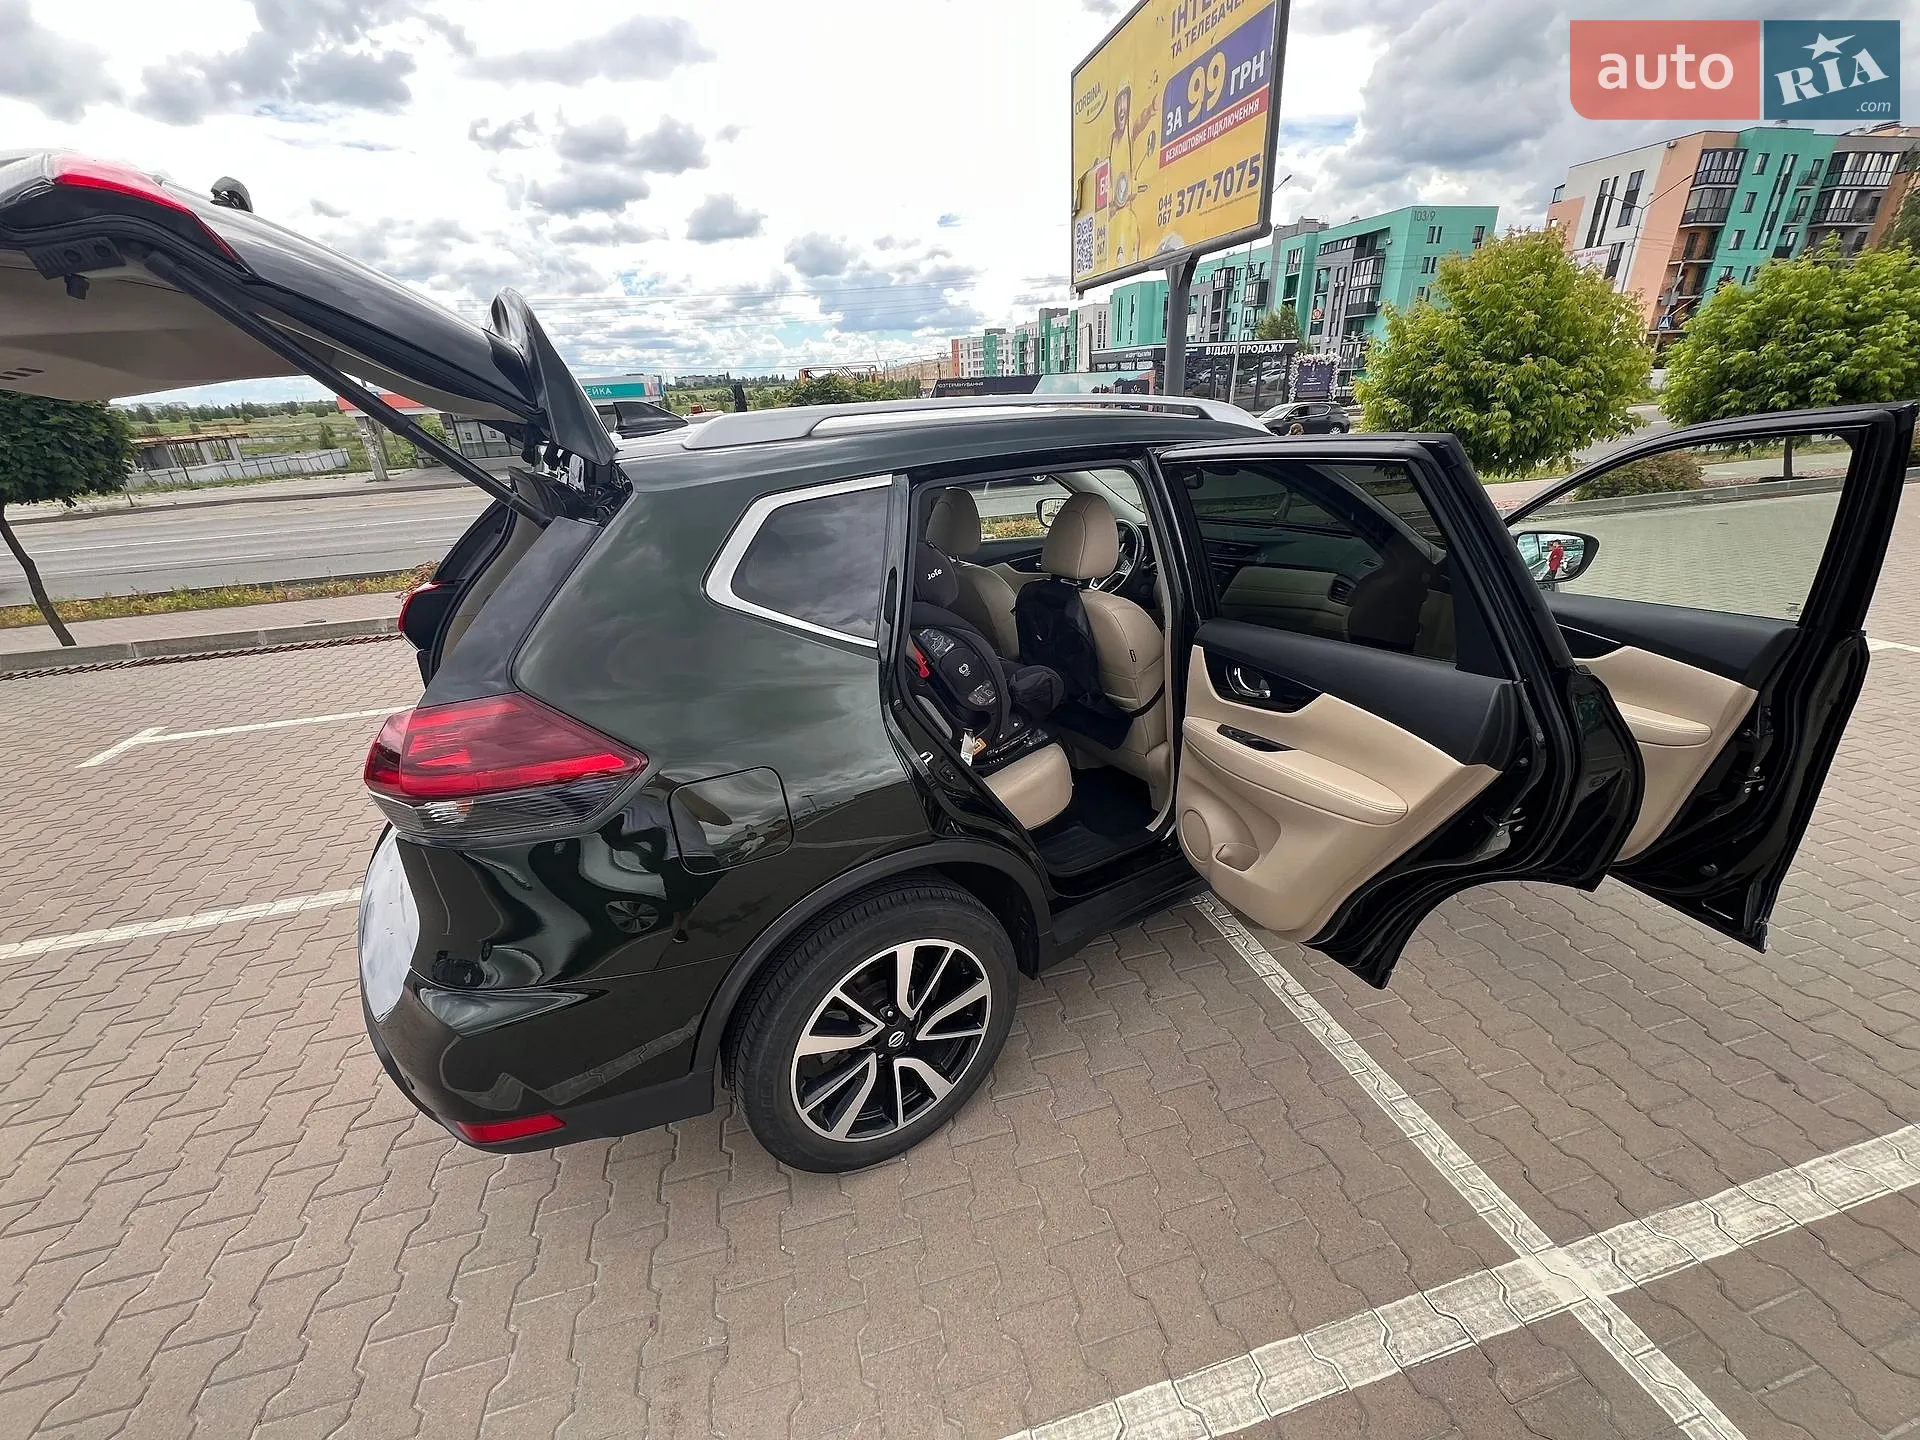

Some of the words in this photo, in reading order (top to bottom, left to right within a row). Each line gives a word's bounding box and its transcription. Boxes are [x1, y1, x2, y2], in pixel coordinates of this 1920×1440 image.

[1171, 39, 1182, 60] ТА
[1184, 0, 1245, 48] ТЕЛЕБАЧЕ
[1166, 105, 1183, 136] ЗА
[1187, 51, 1226, 123] 99
[1229, 49, 1265, 96] ГРН
[1165, 128, 1207, 162] БЕЗКОШТОВНЕ
[1207, 97, 1260, 140] ПІДКЛЮЧЕННЯ
[1157, 209, 1172, 227] 067
[1176, 153, 1261, 218] 377-7075
[1158, 193, 1173, 212] 044
[1205, 346, 1237, 356] ВІДДІЛ
[1240, 343, 1285, 354] ПРОДАЖУ
[586, 387, 612, 396] ЕЙКА
